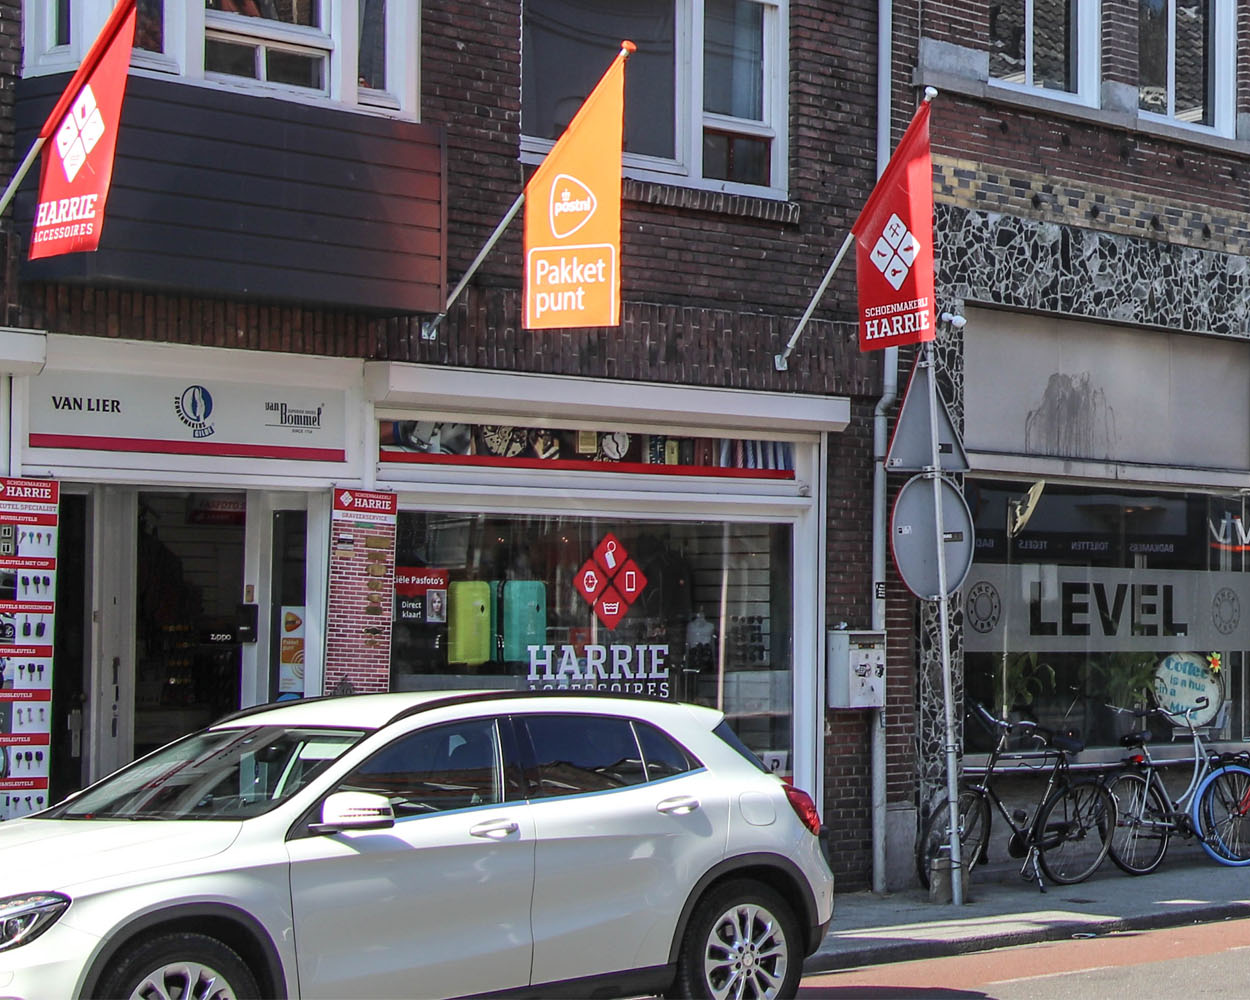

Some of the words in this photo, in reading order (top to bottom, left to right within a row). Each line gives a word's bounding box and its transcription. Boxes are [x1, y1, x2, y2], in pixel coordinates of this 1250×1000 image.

[36, 194, 98, 227] HARRIE
[34, 222, 94, 244] ACCESSOIRES
[536, 257, 606, 285] Pakket
[536, 287, 585, 318] punt
[865, 297, 929, 318] SCHOENMAKERIJ
[865, 310, 930, 340] HARRIE
[51, 396, 83, 411] VAN
[87, 398, 121, 413] LIER
[264, 401, 280, 411] van
[280, 402, 322, 427] Bommel
[6, 486, 52, 499] HARRIE
[20, 504, 57, 512] SPECIALIST
[354, 498, 392, 510] HARRIE
[411, 576, 444, 585] Pasfoto's
[401, 601, 422, 609] Direct
[402, 610, 422, 619] klaar!
[1029, 581, 1189, 637] LEVEL
[527, 644, 670, 681] HARRIE
[1165, 656, 1209, 680] Coffee
[1170, 674, 1179, 685] is
